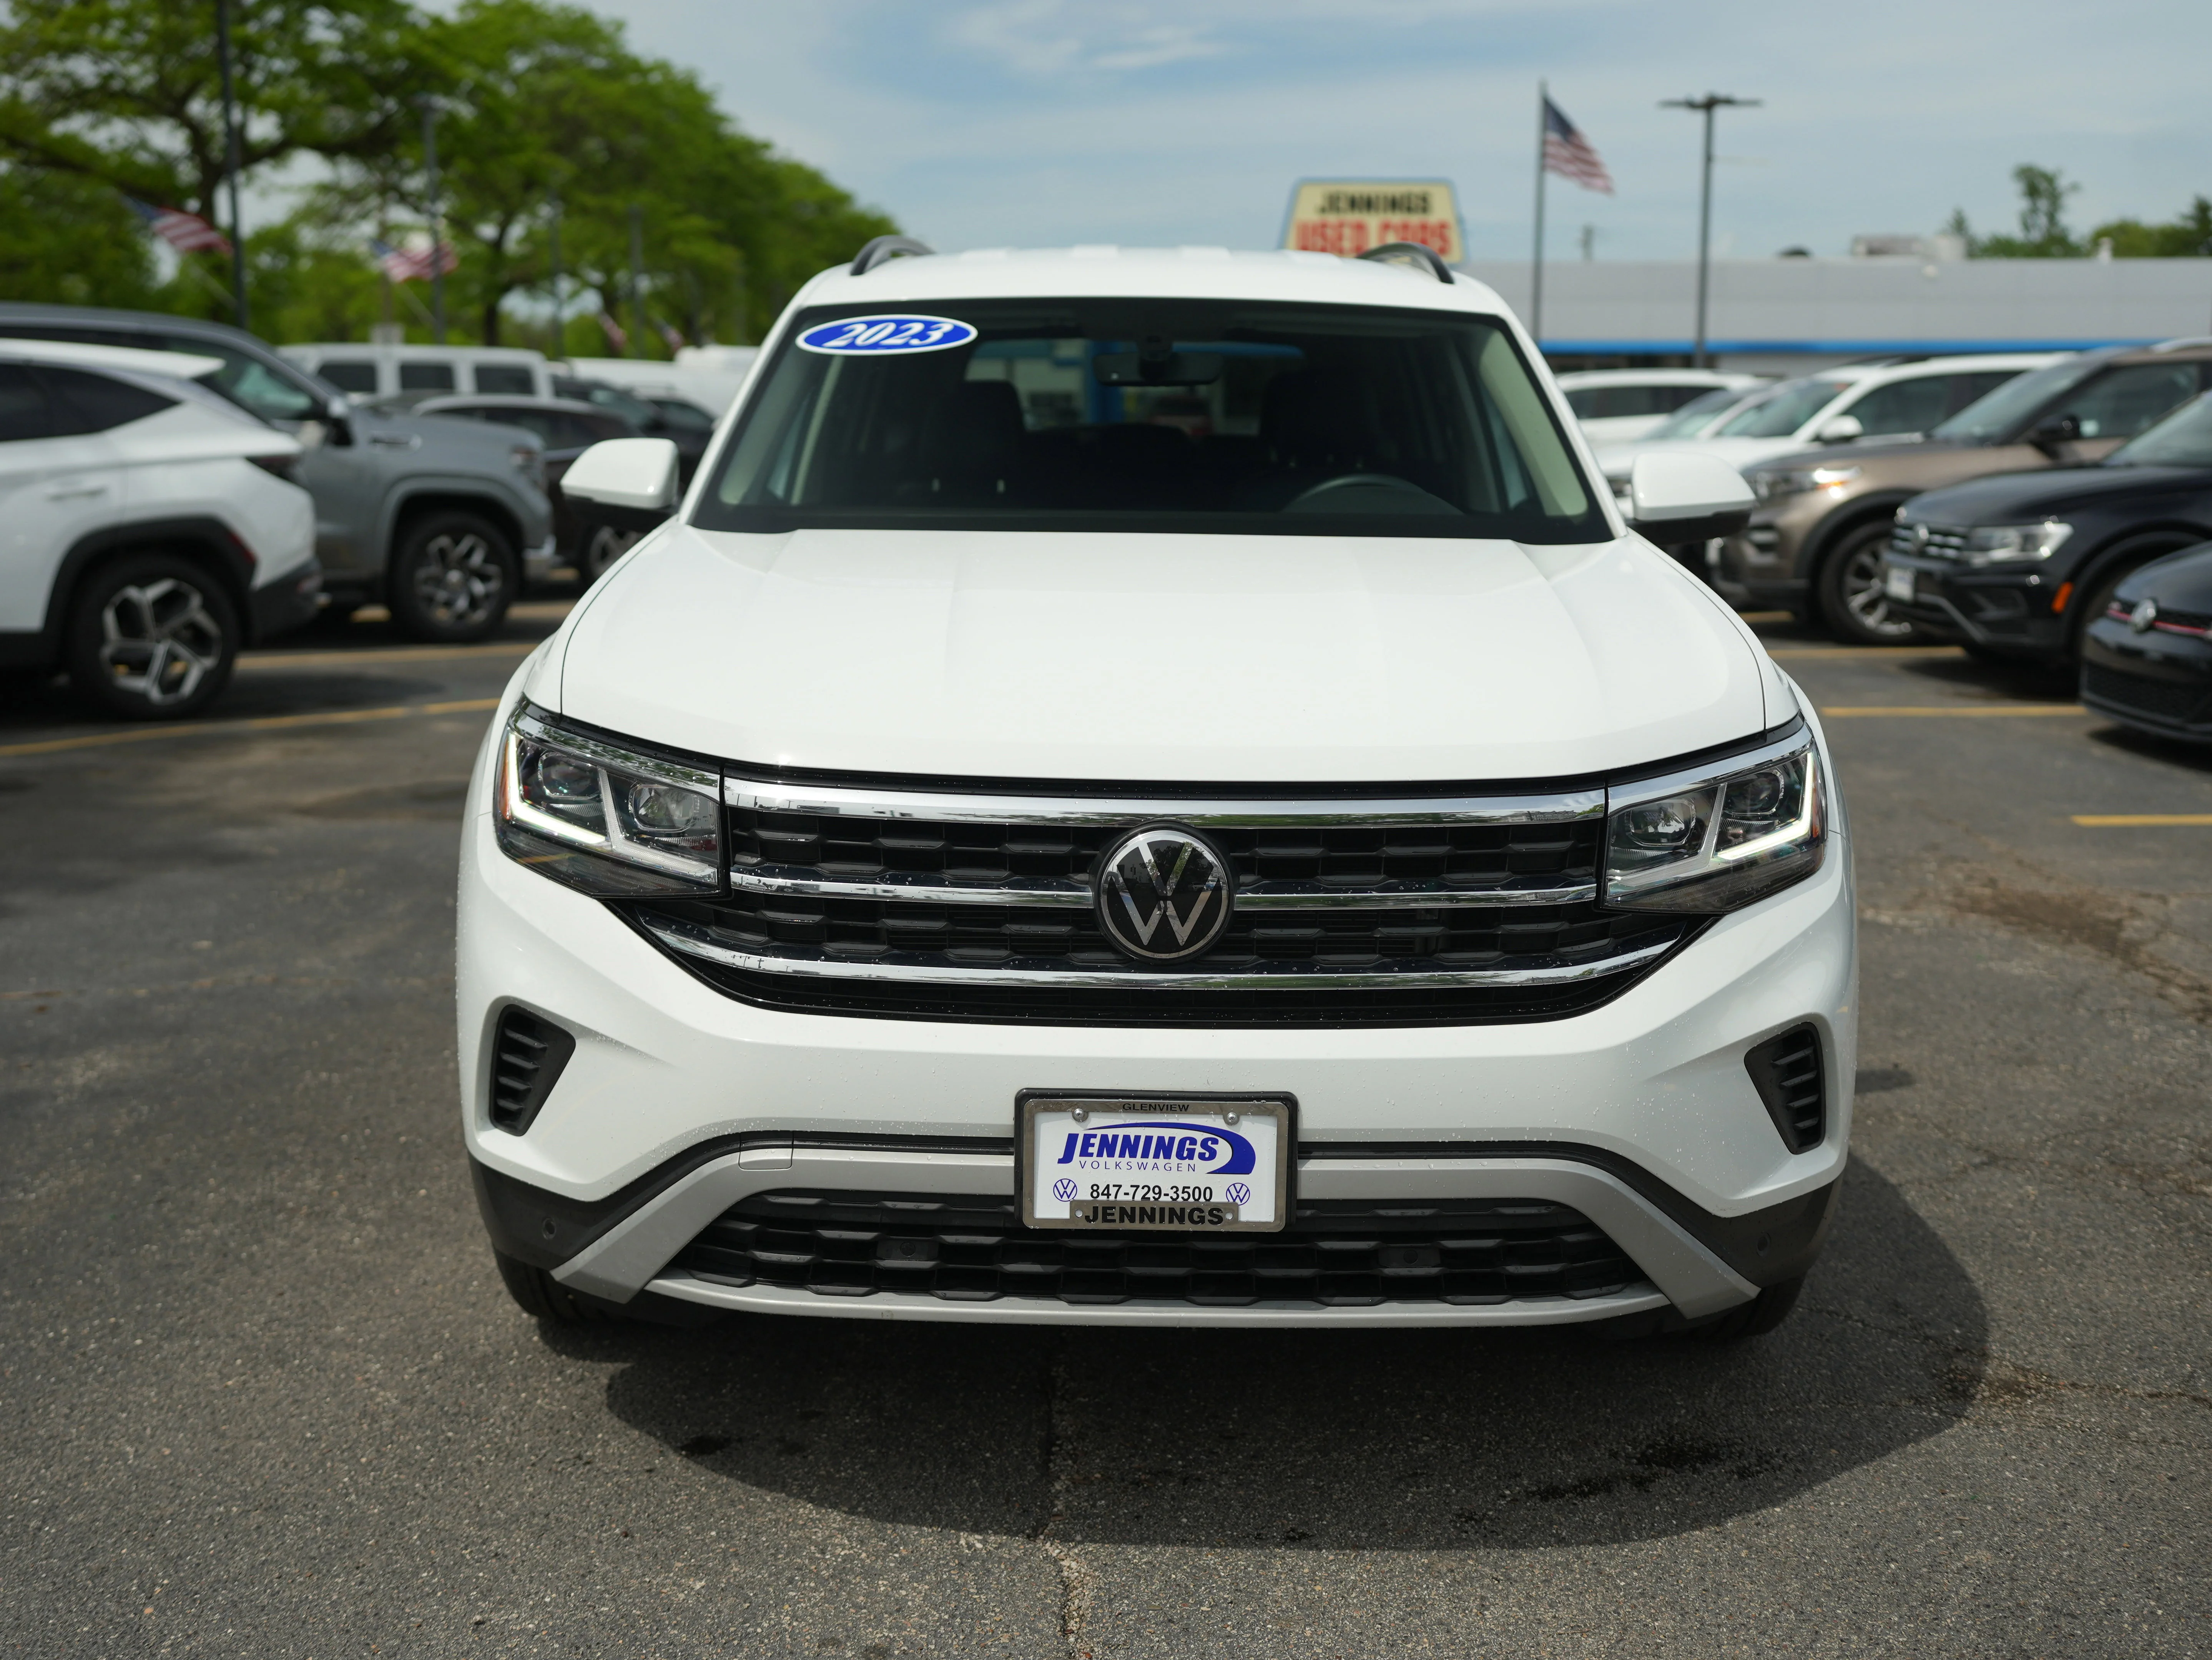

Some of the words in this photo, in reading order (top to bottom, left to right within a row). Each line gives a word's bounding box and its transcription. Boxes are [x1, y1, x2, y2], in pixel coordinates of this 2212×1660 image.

[1318, 192, 1432, 214] JENNINGS
[1295, 219, 1369, 254] USED
[822, 322, 955, 347] 2023
[1102, 831, 1228, 958] VW
[1122, 1102, 1189, 1112] GLENVIEW
[1057, 1133, 1219, 1164] JENNINGS
[1080, 1160, 1196, 1172] VOLKSWAGEN
[1053, 1179, 1077, 1202] VW
[1090, 1184, 1213, 1201] 847-729-3500
[1226, 1183, 1250, 1205] VW
[1084, 1206, 1224, 1225] JENNINGS
